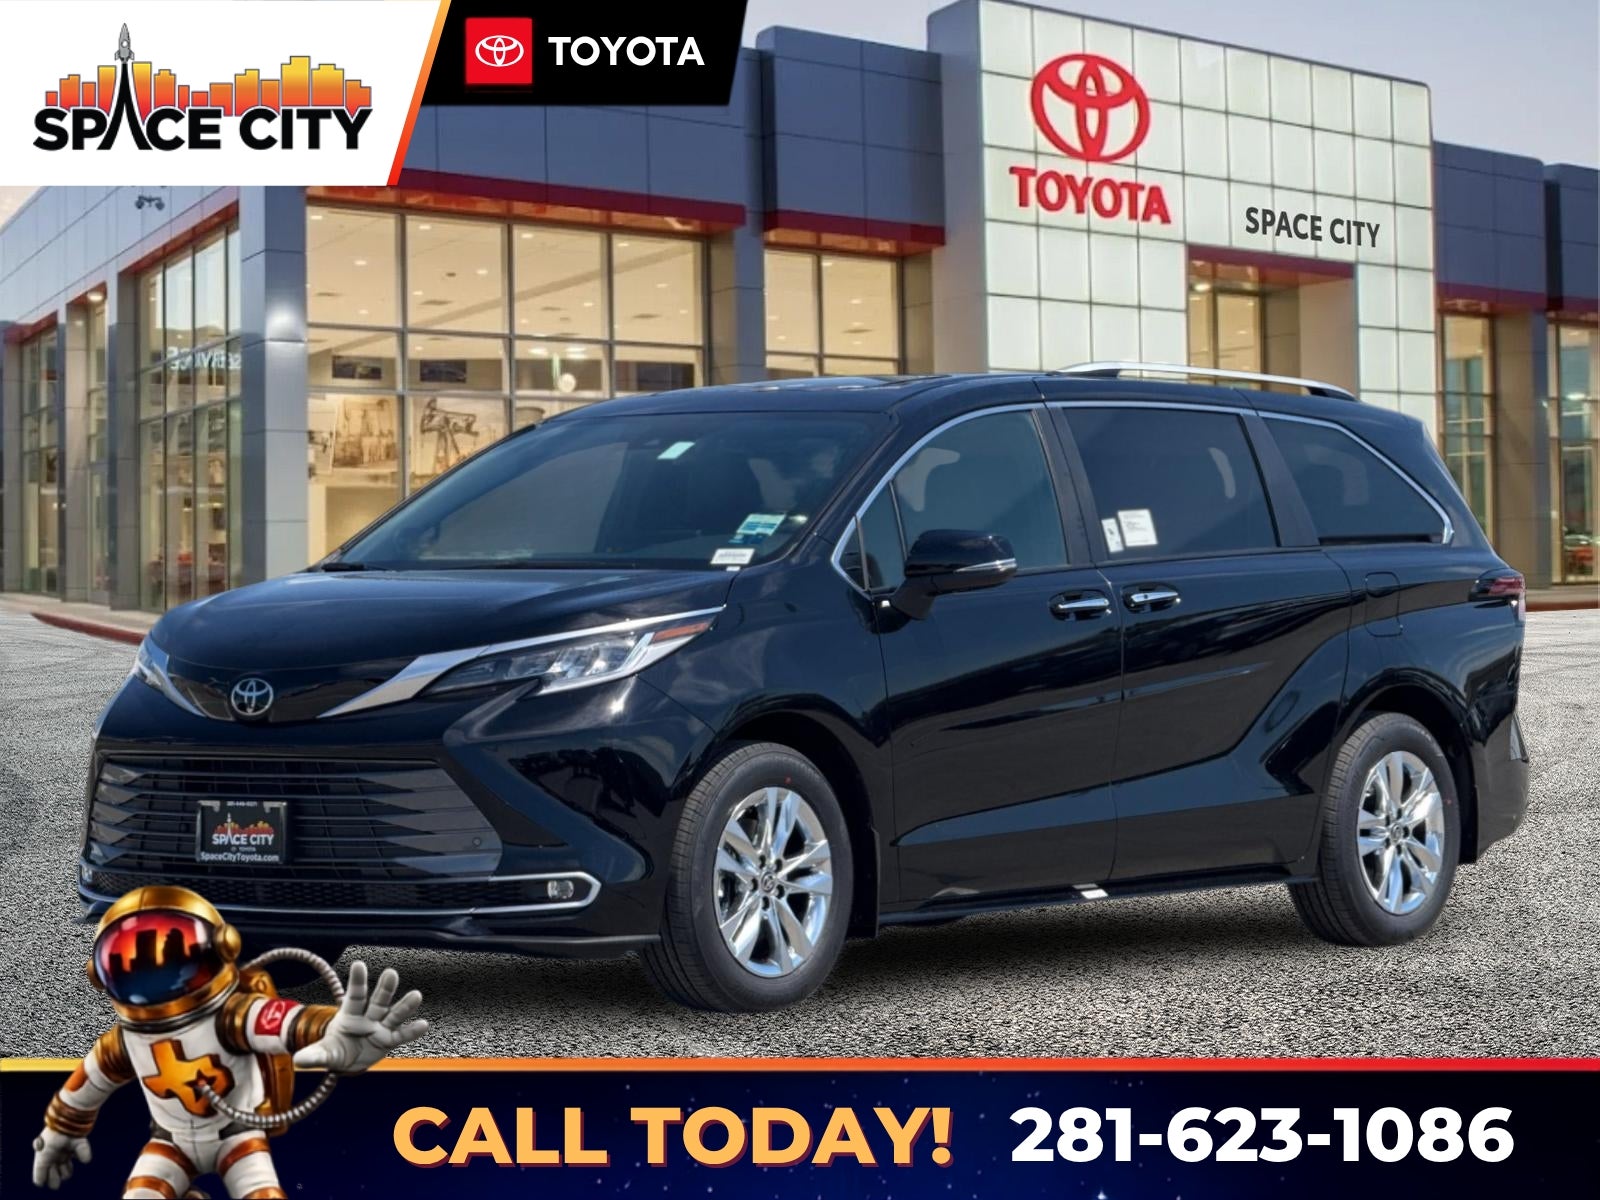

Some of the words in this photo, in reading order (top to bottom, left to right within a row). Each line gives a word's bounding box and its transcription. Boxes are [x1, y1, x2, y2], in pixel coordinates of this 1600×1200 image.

[1009, 166, 1171, 224] TOYOTA
[1245, 206, 1323, 242] SPACE
[1329, 217, 1381, 248] CITY
[212, 834, 248, 845] SPACE
[249, 834, 274, 845] CITY
[200, 851, 279, 862] SpaceCityToyota.com
